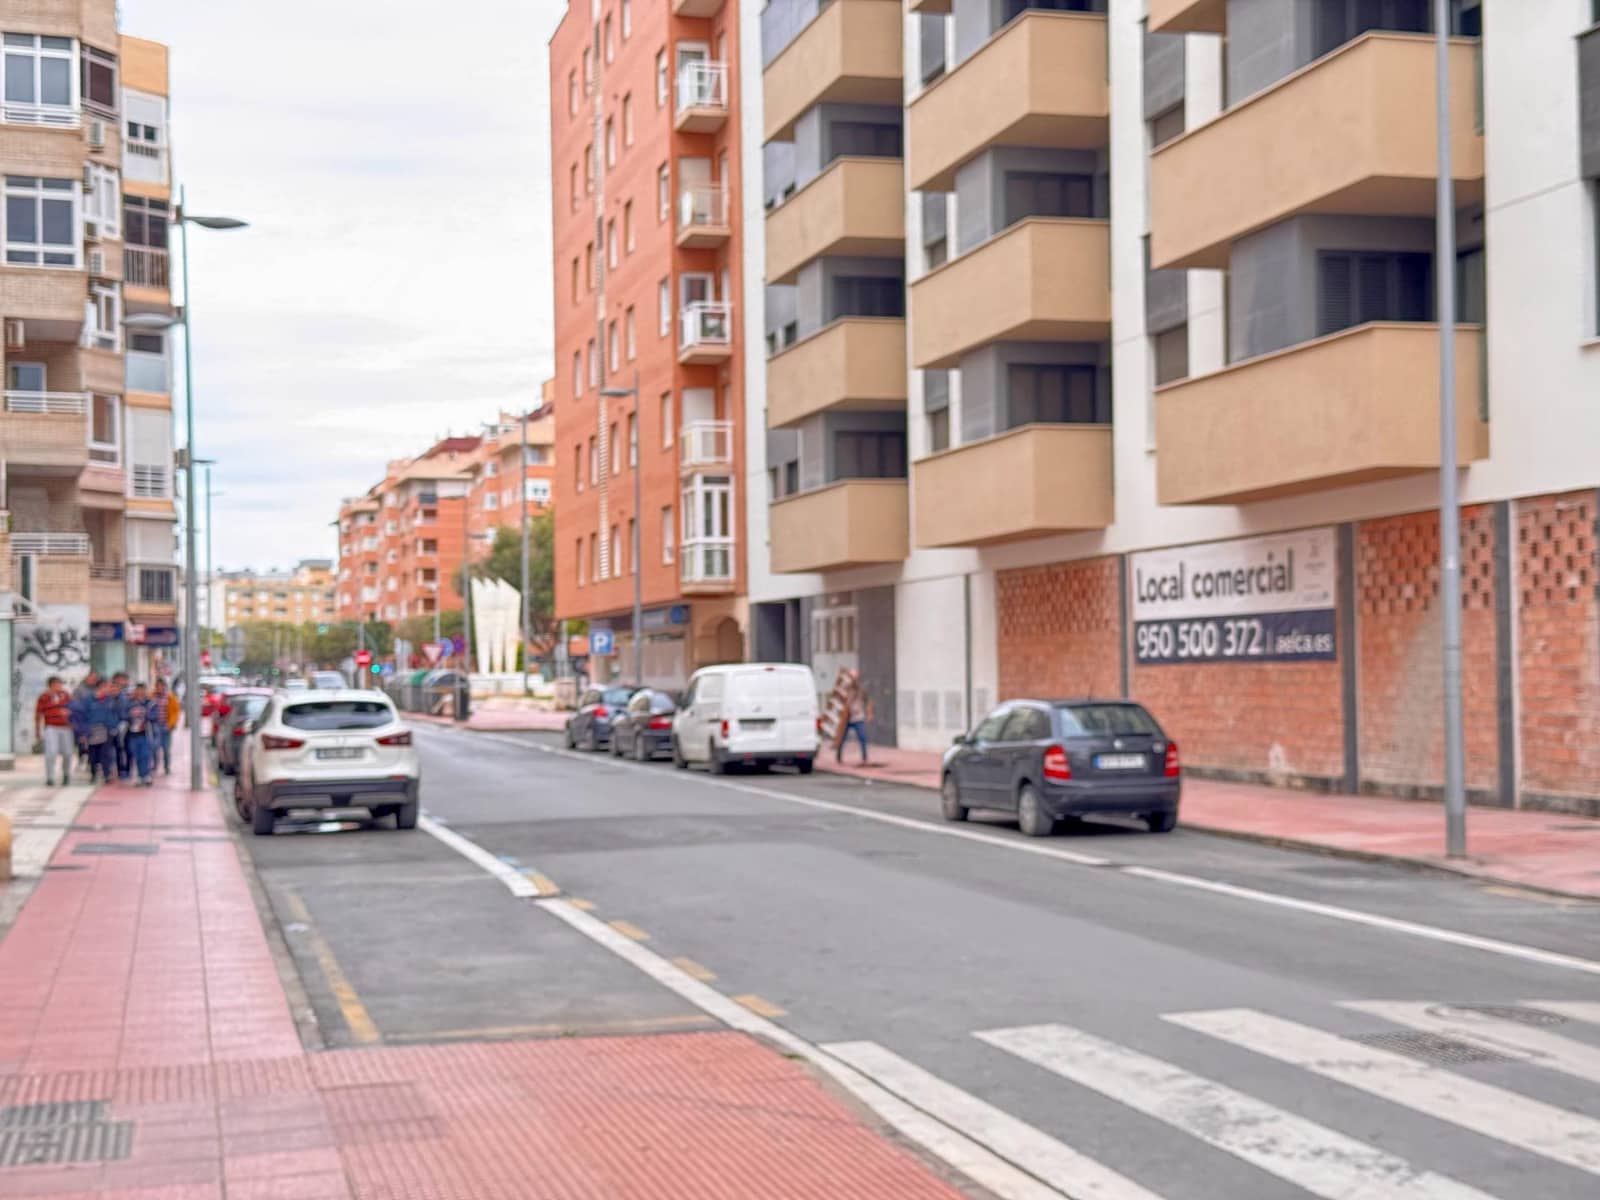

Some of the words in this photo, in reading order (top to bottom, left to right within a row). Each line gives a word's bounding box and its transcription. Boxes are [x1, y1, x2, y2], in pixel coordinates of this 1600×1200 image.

[1137, 561, 1184, 602] Local
[1192, 547, 1293, 598] comercial
[593, 632, 609, 653] P
[1138, 623, 1173, 658] 950
[1178, 621, 1218, 657] 500
[1223, 619, 1263, 655] 372
